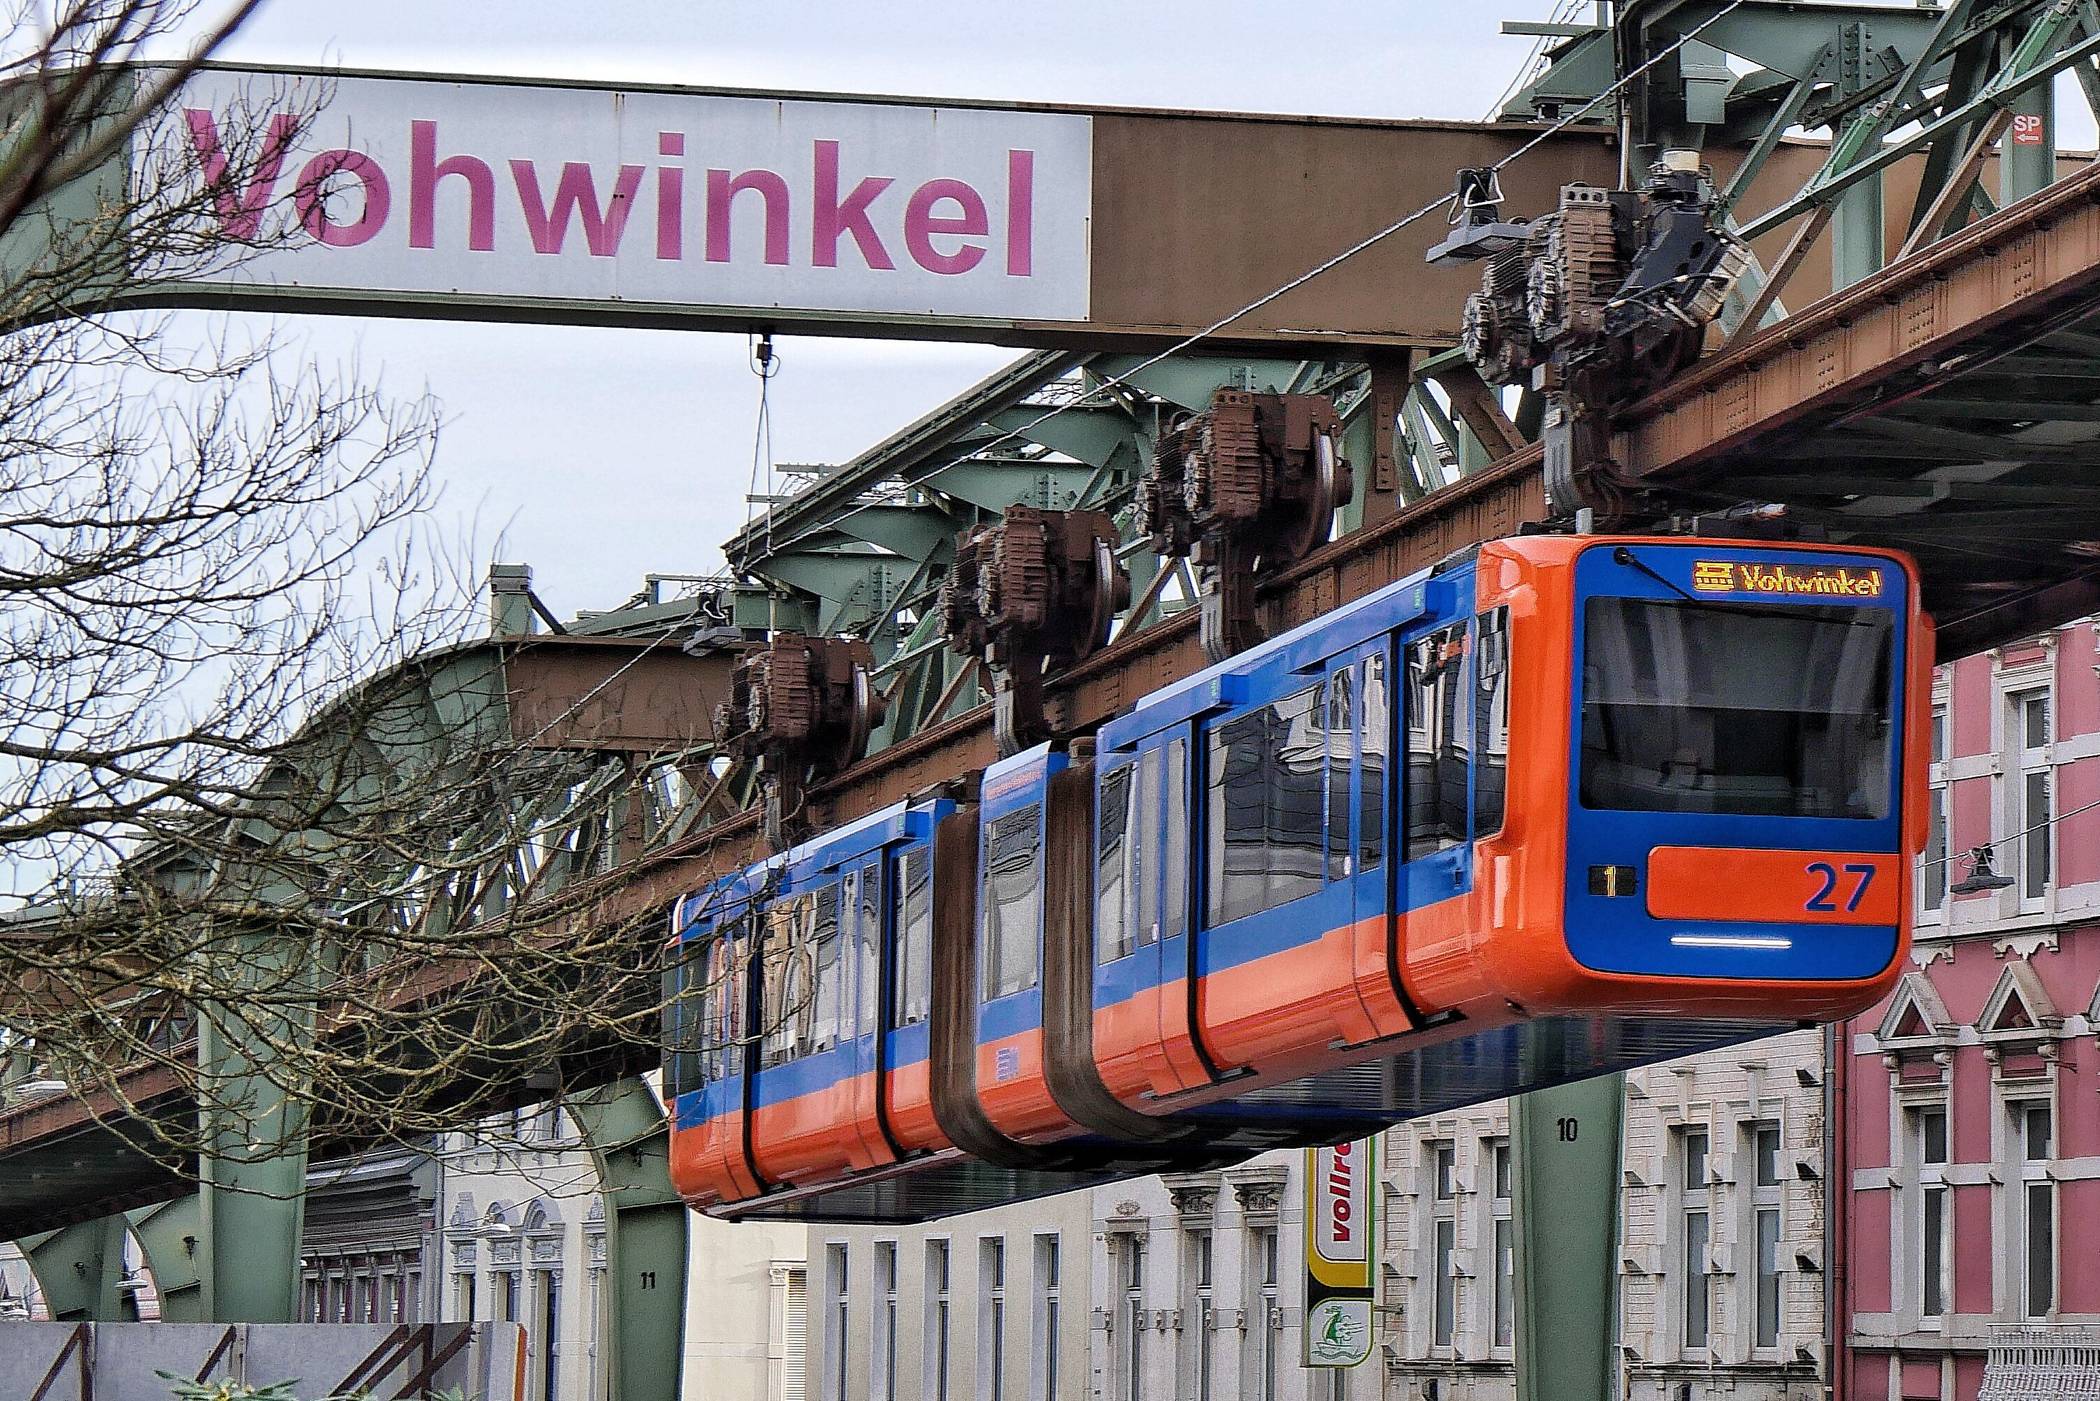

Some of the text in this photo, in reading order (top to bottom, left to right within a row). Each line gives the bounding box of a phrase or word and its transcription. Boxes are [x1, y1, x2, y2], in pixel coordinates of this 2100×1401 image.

[2013, 115, 2041, 132] SP
[184, 107, 1035, 277] Vohwinkel
[1741, 563, 1881, 596] Vohwinkel
[1604, 866, 1617, 897] 1
[1805, 862, 1877, 912] 27
[1557, 1117, 1578, 1142] 10
[640, 1271, 656, 1290] 11
